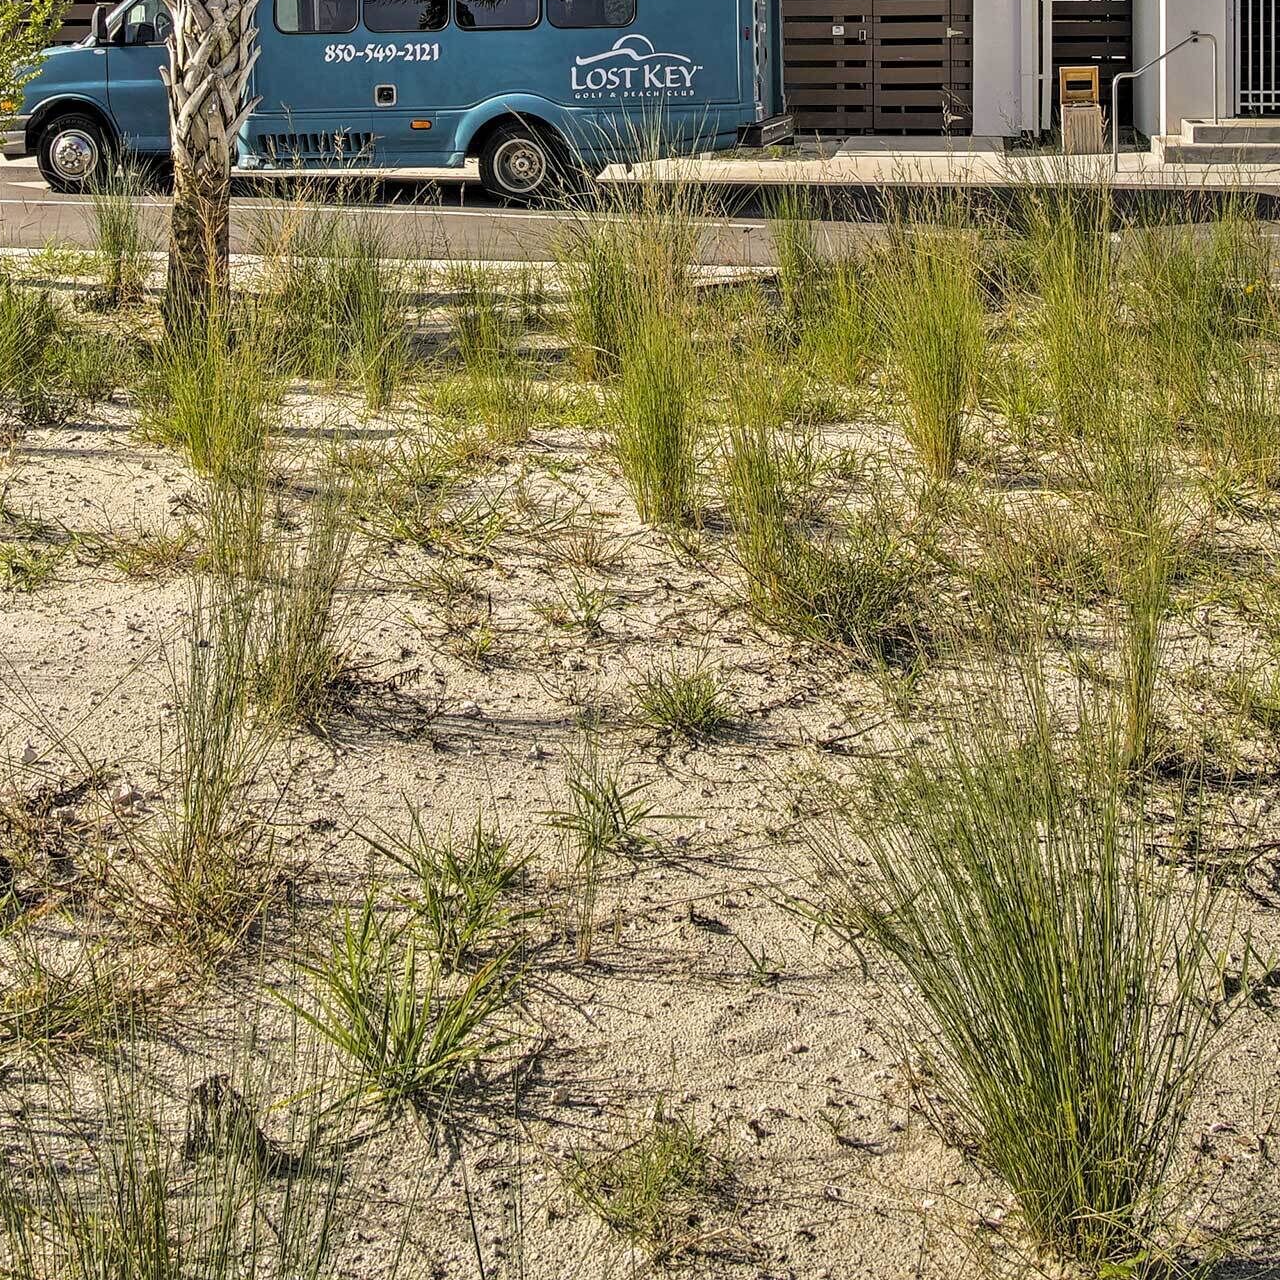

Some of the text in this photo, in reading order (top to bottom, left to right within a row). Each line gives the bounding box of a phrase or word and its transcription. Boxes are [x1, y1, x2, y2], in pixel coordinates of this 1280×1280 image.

[324, 43, 440, 63] 850-549-2121
[571, 64, 697, 90] LOST KEY
[575, 91, 603, 99] GOLF
[624, 90, 660, 98] BEACH
[667, 89, 696, 97] CLUB
